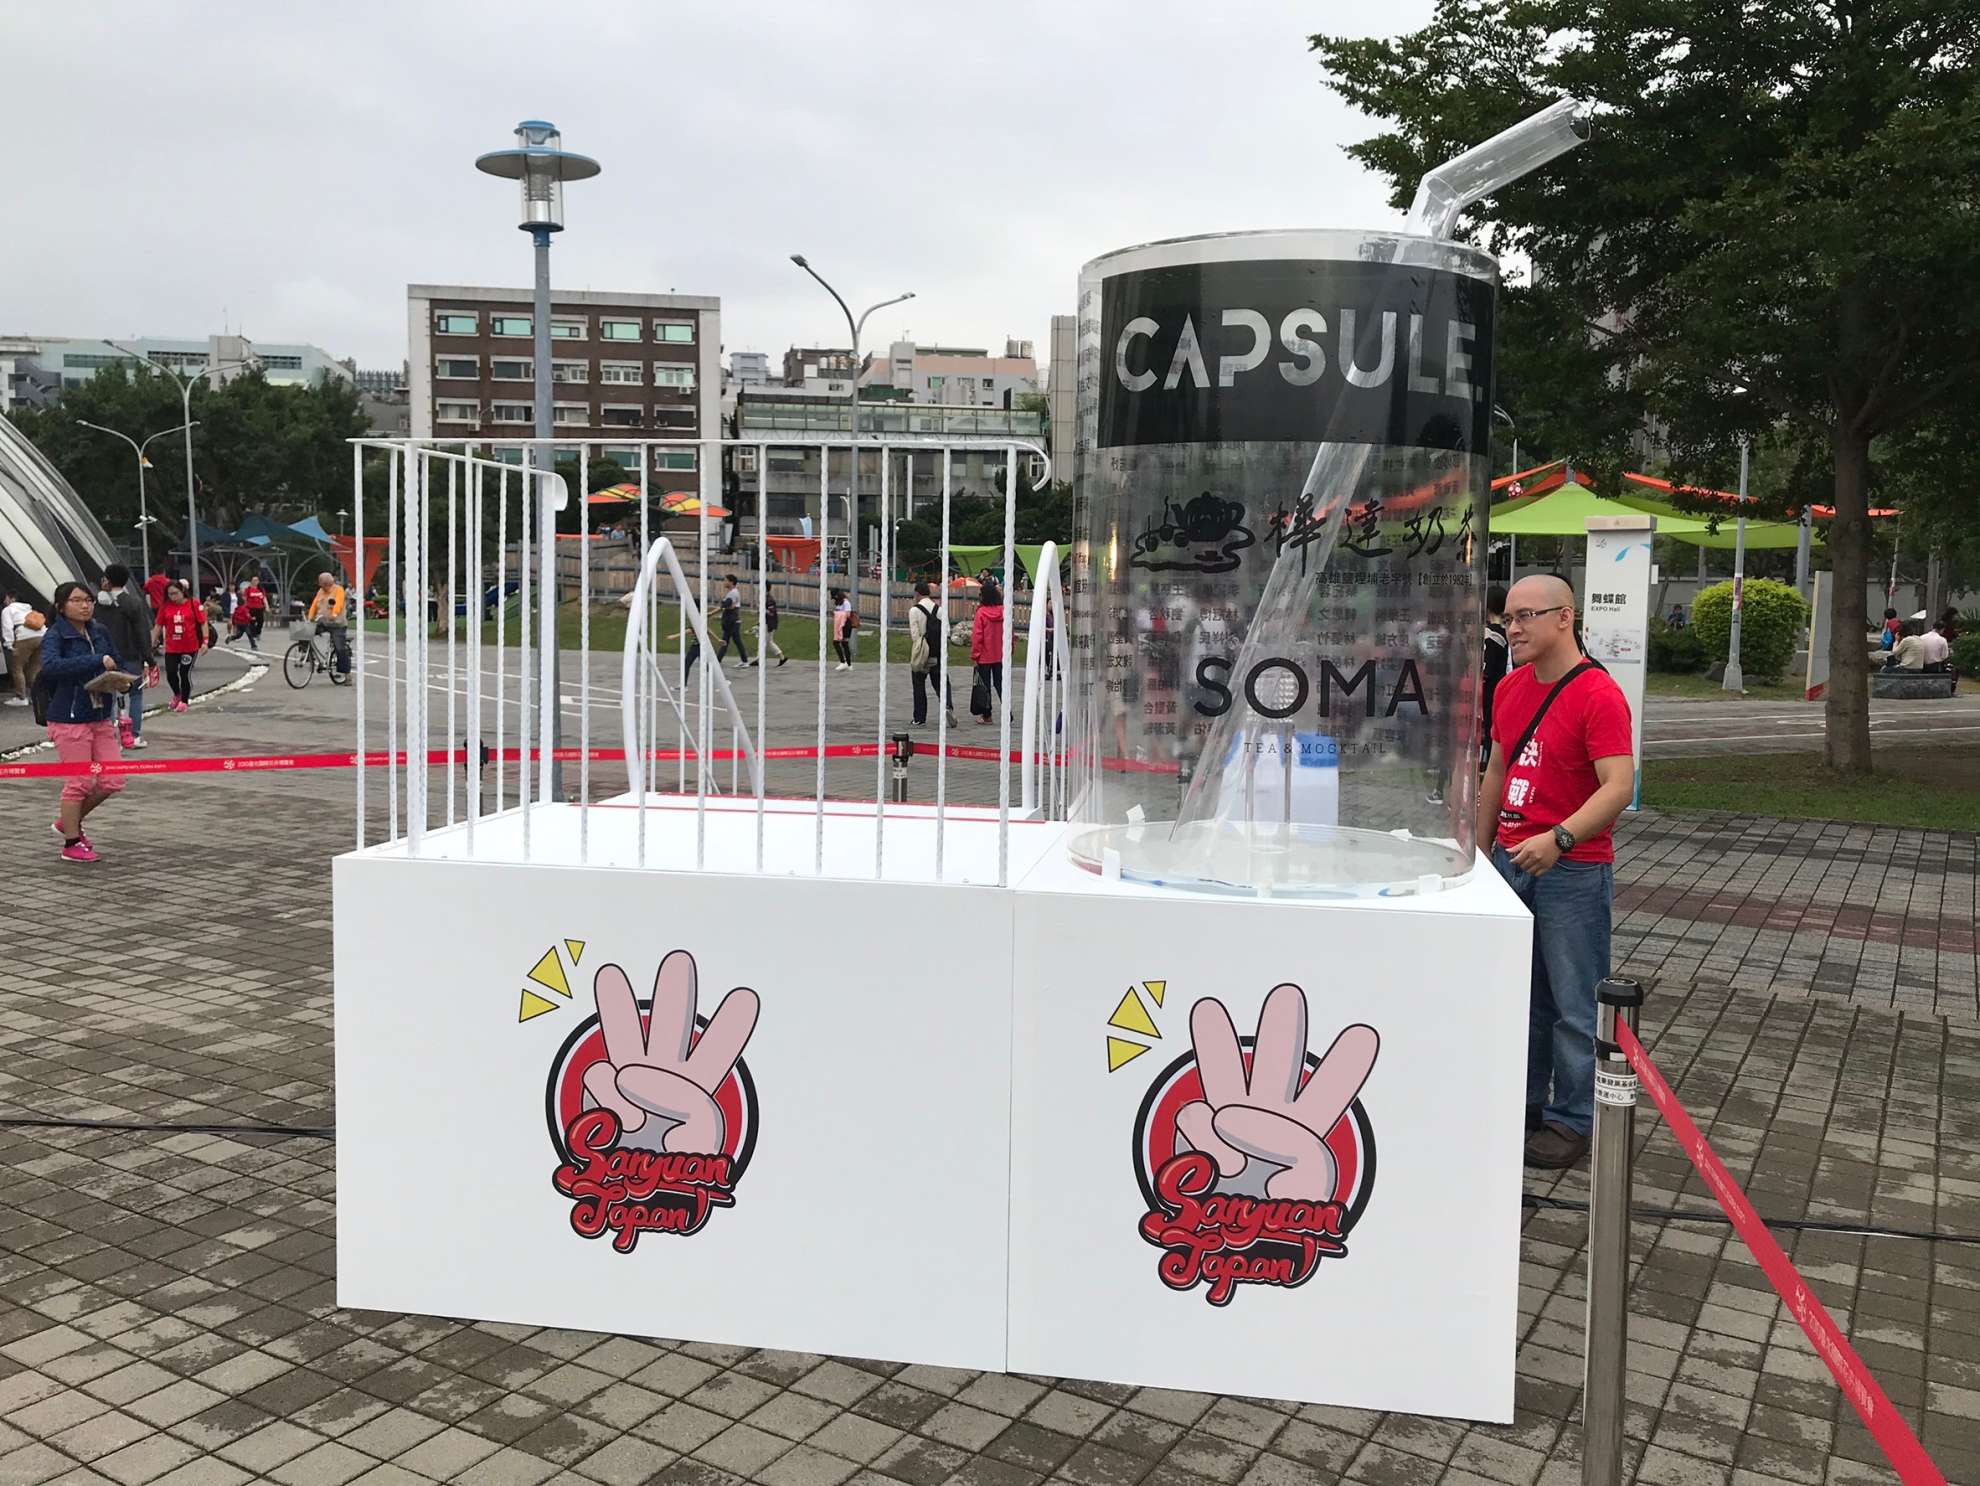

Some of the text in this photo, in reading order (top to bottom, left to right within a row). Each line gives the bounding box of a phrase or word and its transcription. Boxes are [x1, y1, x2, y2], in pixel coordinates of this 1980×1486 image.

[1194, 656, 1430, 720] SOMA
[1243, 742, 1387, 755] TEA & MOCKTAIL
